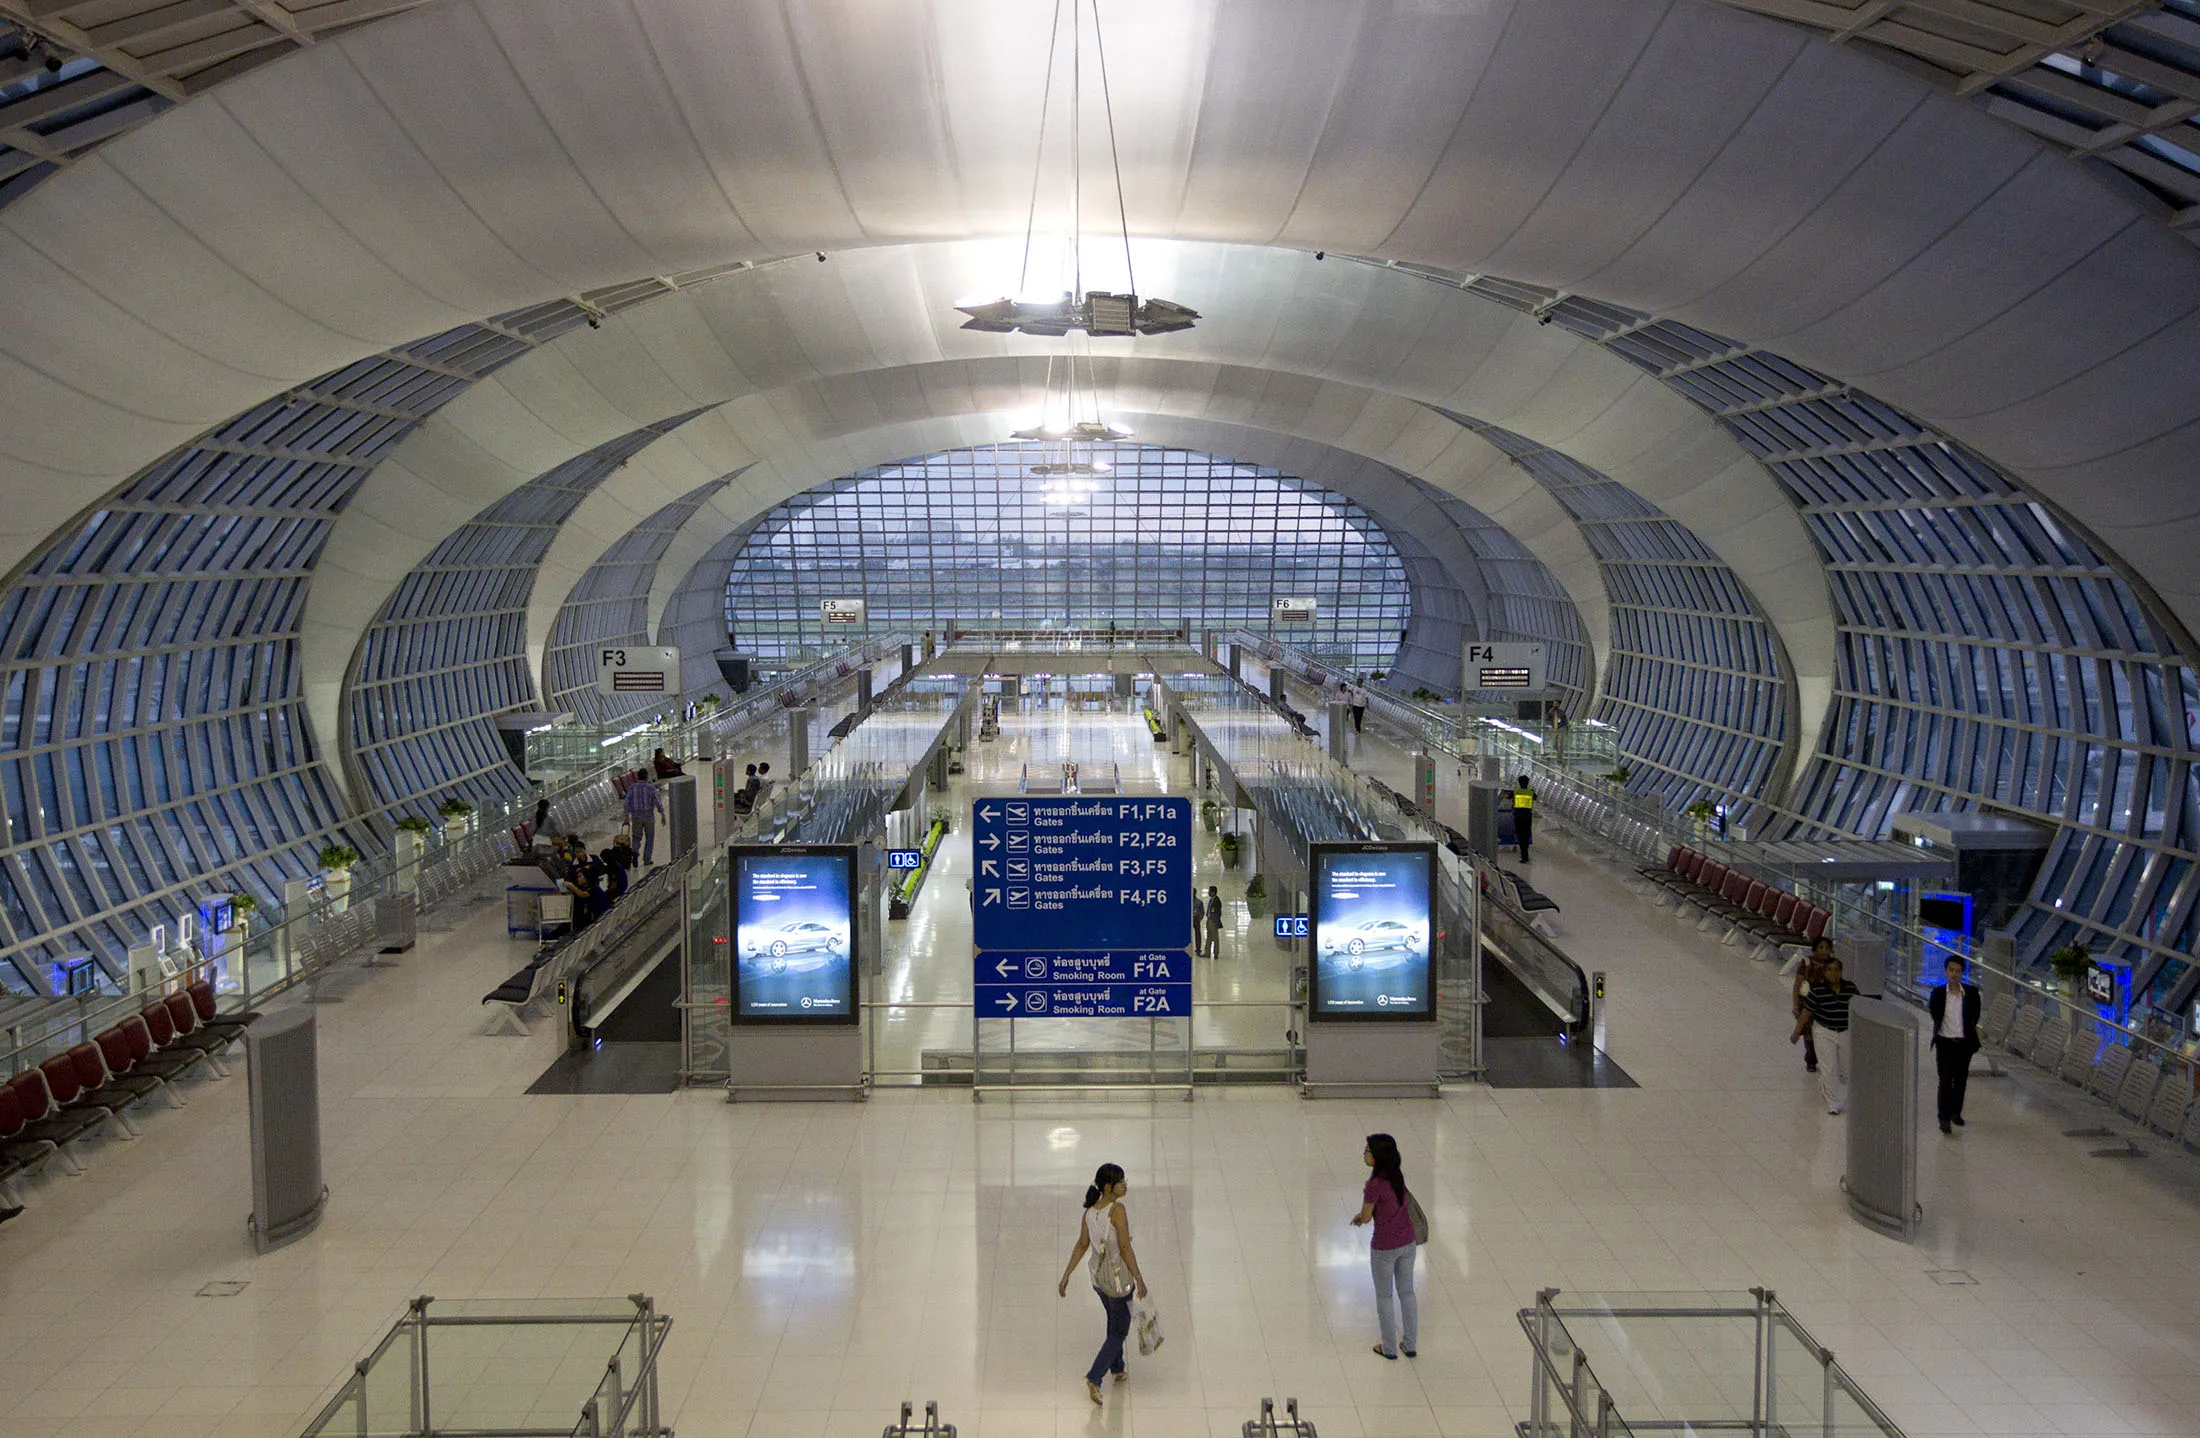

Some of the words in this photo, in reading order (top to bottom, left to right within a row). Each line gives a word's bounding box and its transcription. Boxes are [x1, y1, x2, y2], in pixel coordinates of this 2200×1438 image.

[823, 601, 836, 610] F5
[1276, 599, 1290, 608] F6
[603, 650, 626, 666] F3
[1470, 646, 1494, 662] F4
[1119, 805, 1177, 821] F1,F1a
[1034, 818, 1064, 826] Gates
[1119, 832, 1177, 849] F2,F2a
[1034, 845, 1064, 854] Gates
[1119, 860, 1167, 877] F3,F5
[1034, 873, 1064, 882] Gates
[1119, 889, 1167, 906] F4,F6
[1034, 901, 1064, 909] Gates
[1134, 963, 1171, 977] F1A
[1053, 972, 1094, 981] Smoking
[1134, 997, 1171, 1011] F2A
[1053, 1006, 1094, 1015] Smoking
